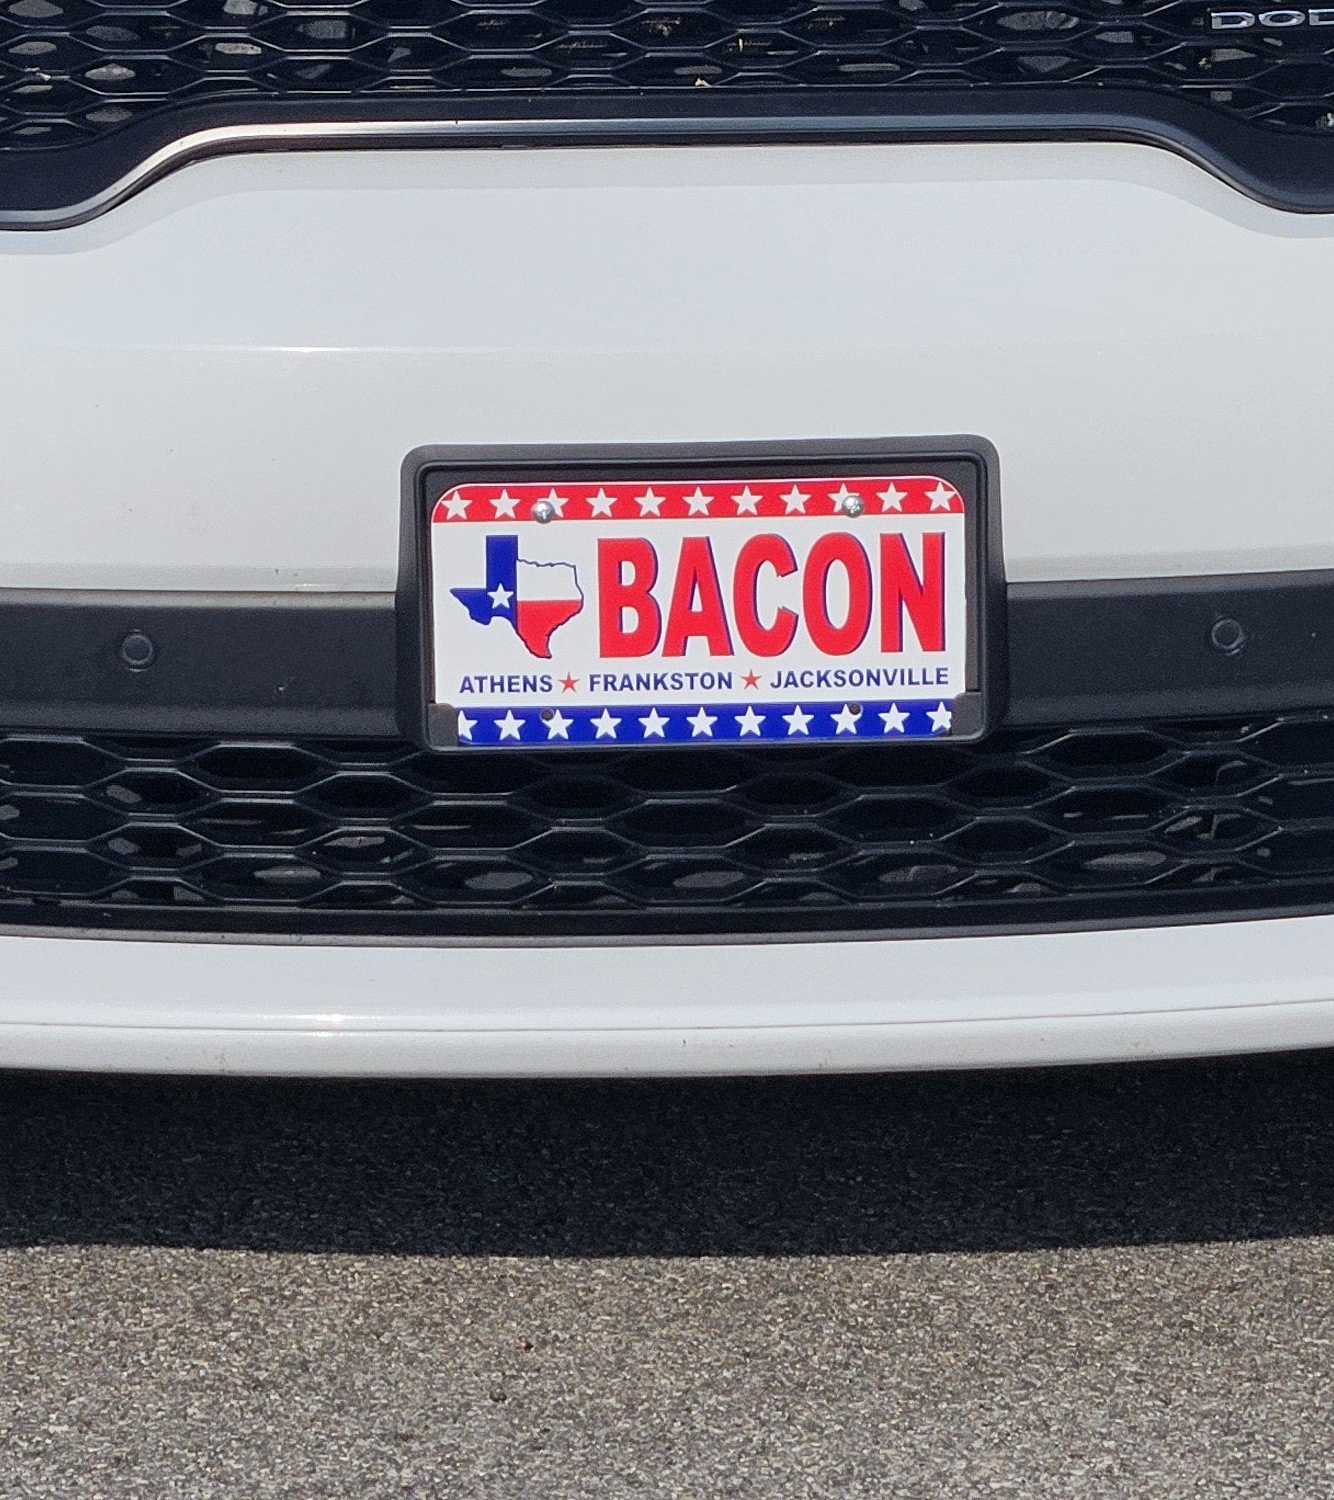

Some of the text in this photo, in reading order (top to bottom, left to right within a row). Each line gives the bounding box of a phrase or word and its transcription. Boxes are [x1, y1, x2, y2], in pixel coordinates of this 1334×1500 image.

[597, 531, 947, 659] BACON
[459, 667, 950, 694] ATHENS FRANKSTON JACKSONVILLE
